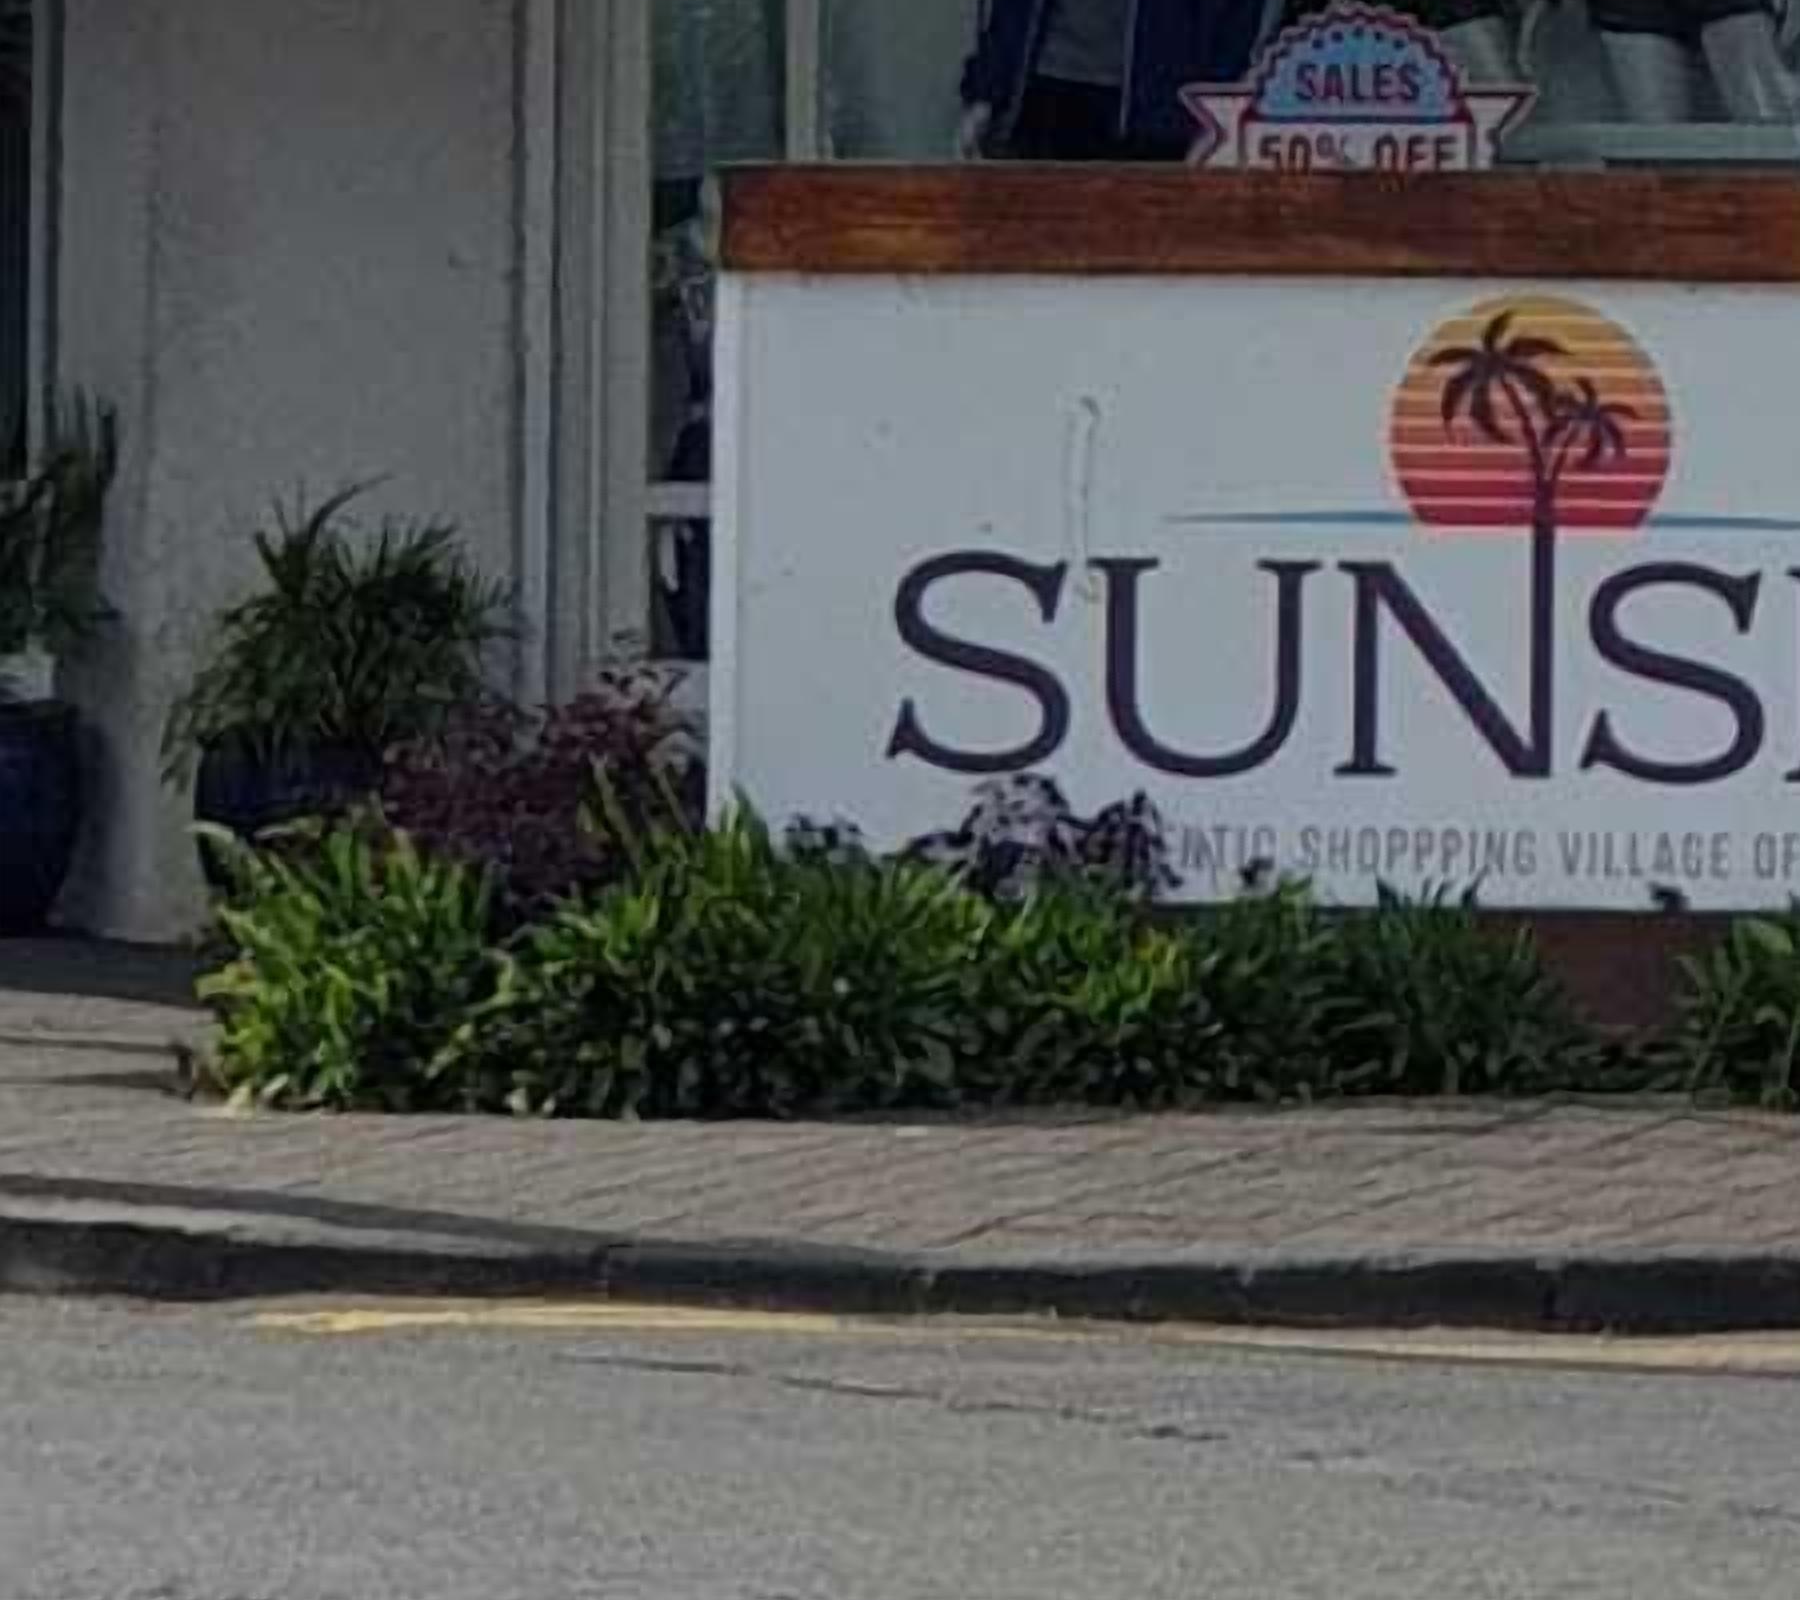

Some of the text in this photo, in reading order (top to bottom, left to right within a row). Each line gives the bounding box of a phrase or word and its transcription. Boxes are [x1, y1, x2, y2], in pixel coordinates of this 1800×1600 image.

[1295, 62, 1421, 101] SALES
[1374, 134, 1457, 169] OFF
[1301, 825, 1537, 877] SHOPPPING
[1557, 831, 1730, 880] VILLAGE
[1753, 831, 1800, 880] OF
